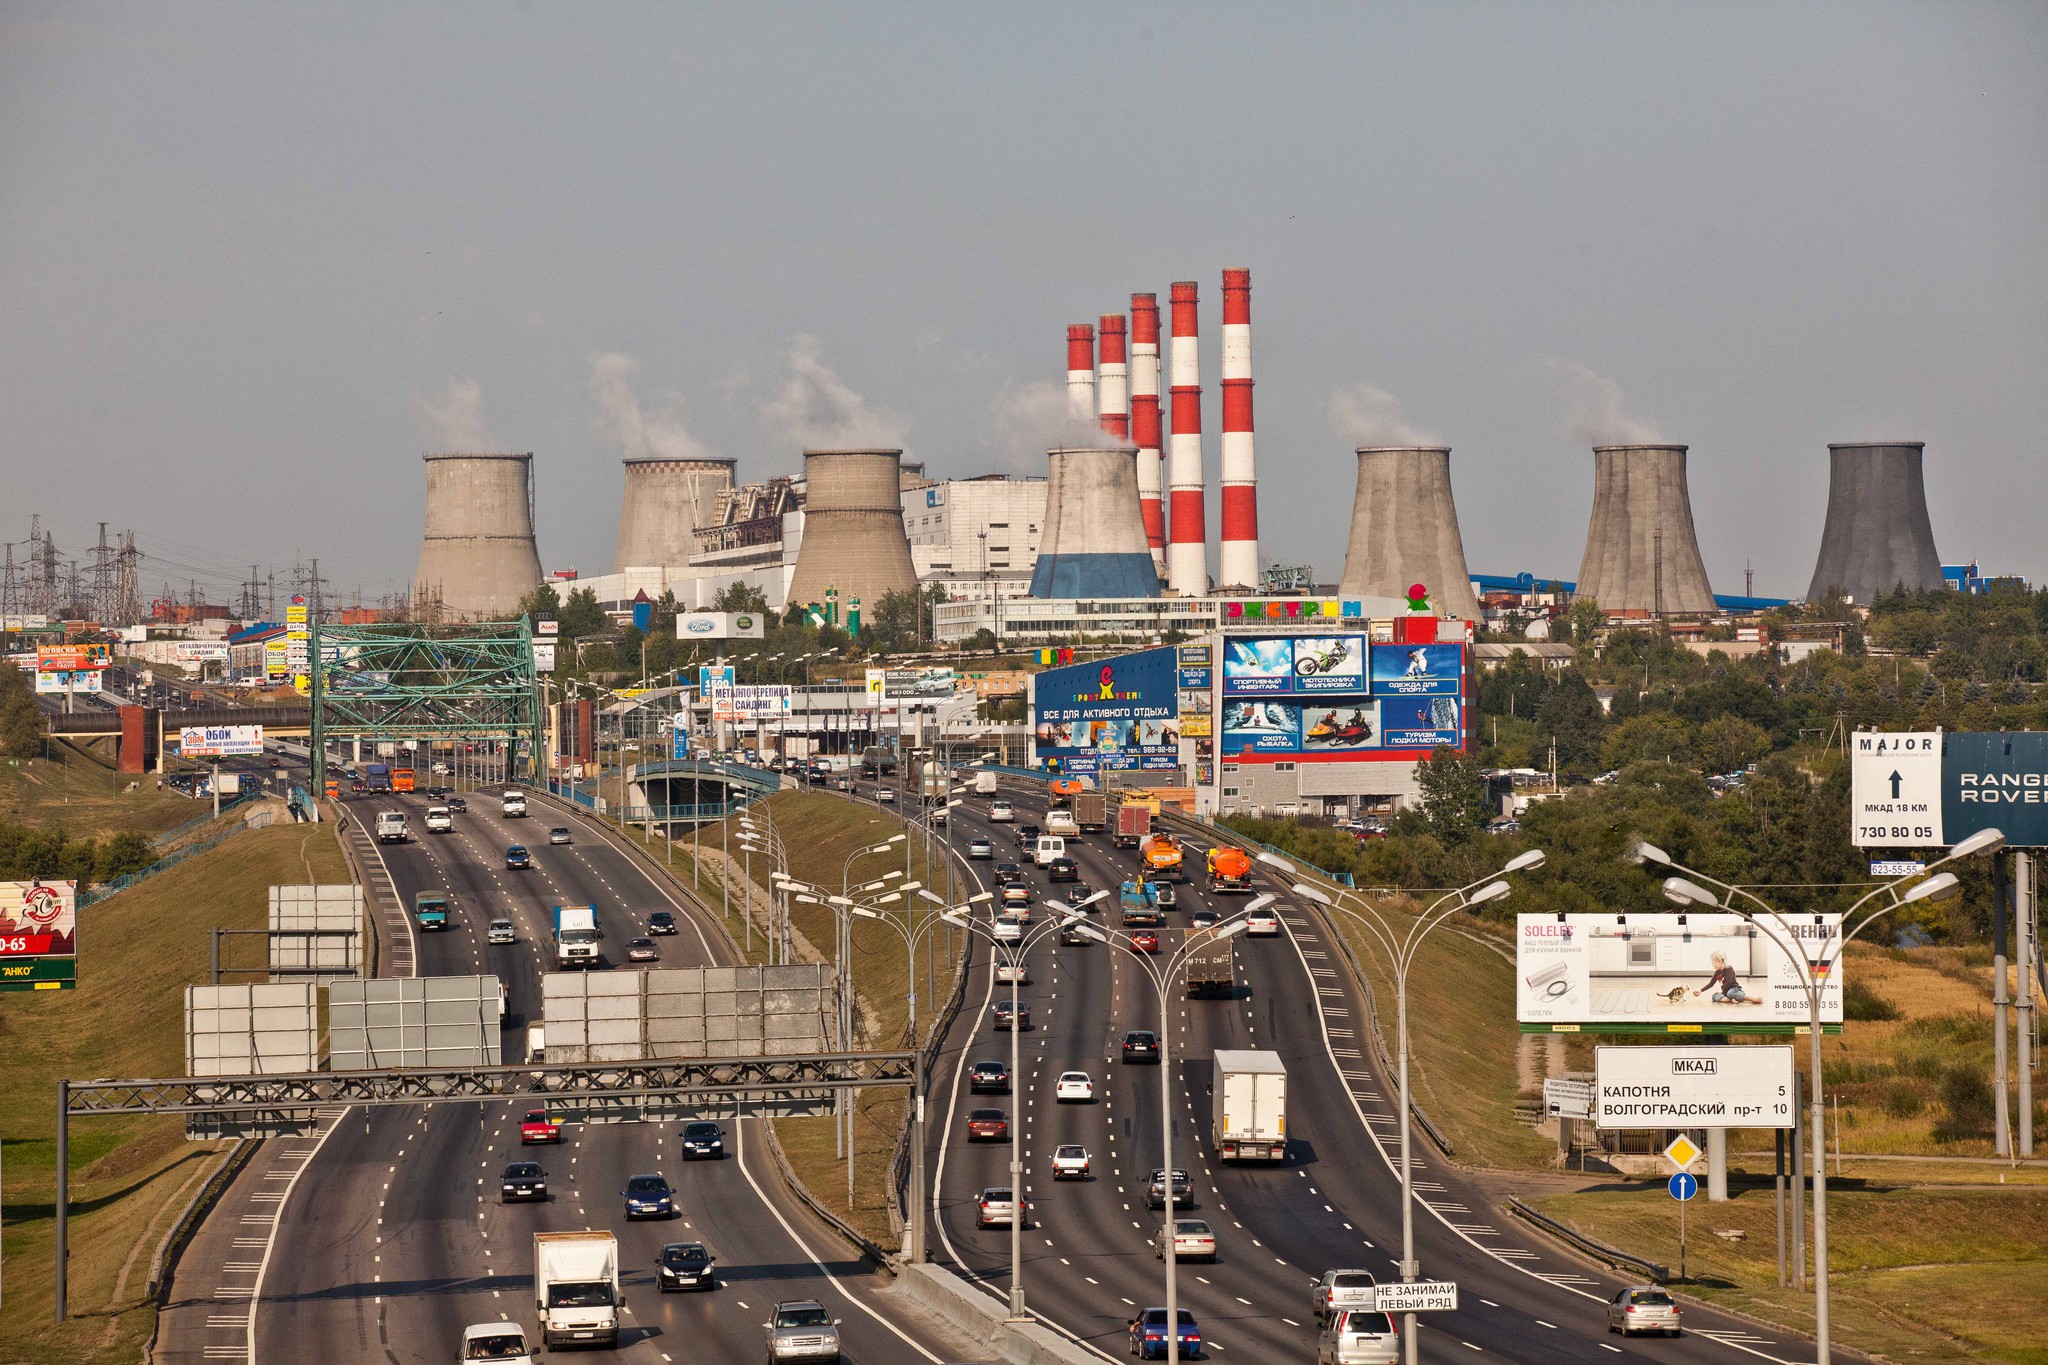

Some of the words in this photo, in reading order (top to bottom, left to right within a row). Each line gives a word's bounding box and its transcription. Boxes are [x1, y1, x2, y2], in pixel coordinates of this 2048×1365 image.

[1228, 601, 1361, 618] ЭКСТРИМ
[691, 621, 712, 631] Ford
[1034, 648, 1074, 664] СПОРТ
[735, 699, 772, 710] САЙДИНГ
[1044, 710, 1059, 719] ВСЕ
[1063, 710, 1079, 719] ДЛЯ
[1083, 708, 1130, 718] АКТИВНОГО
[1134, 707, 1169, 717] ОТДЫХА
[206, 730, 231, 740] ОБОИ
[1860, 739, 1932, 750] MAJOR
[1961, 774, 2048, 786] RANG
[1961, 790, 2048, 803] ROVE
[1865, 804, 1893, 813] МКАД
[1860, 827, 1886, 837] 730
[1891, 827, 1909, 837] 80
[1914, 827, 1932, 837] 05
[1872, 865, 1917, 874] 623-55-55
[0, 938, 26, 950] 0-65
[2, 967, 34, 976] "АНКО"
[1674, 1060, 1715, 1073] МКАД
[1604, 1086, 1670, 1097] КАПОТНЯ
[1778, 1085, 1785, 1096] 5
[1604, 1102, 1726, 1117] ВОЛГОГРАДСКИЙ
[1734, 1106, 1762, 1116] пр-т
[1773, 1104, 1787, 1114] 10
[1377, 1286, 1392, 1296] НЕ
[1396, 1284, 1455, 1295] ЗАНИМАЙ
[1380, 1297, 1423, 1309] ЛЕВЫЙ
[1428, 1298, 1451, 1309] РЯД
